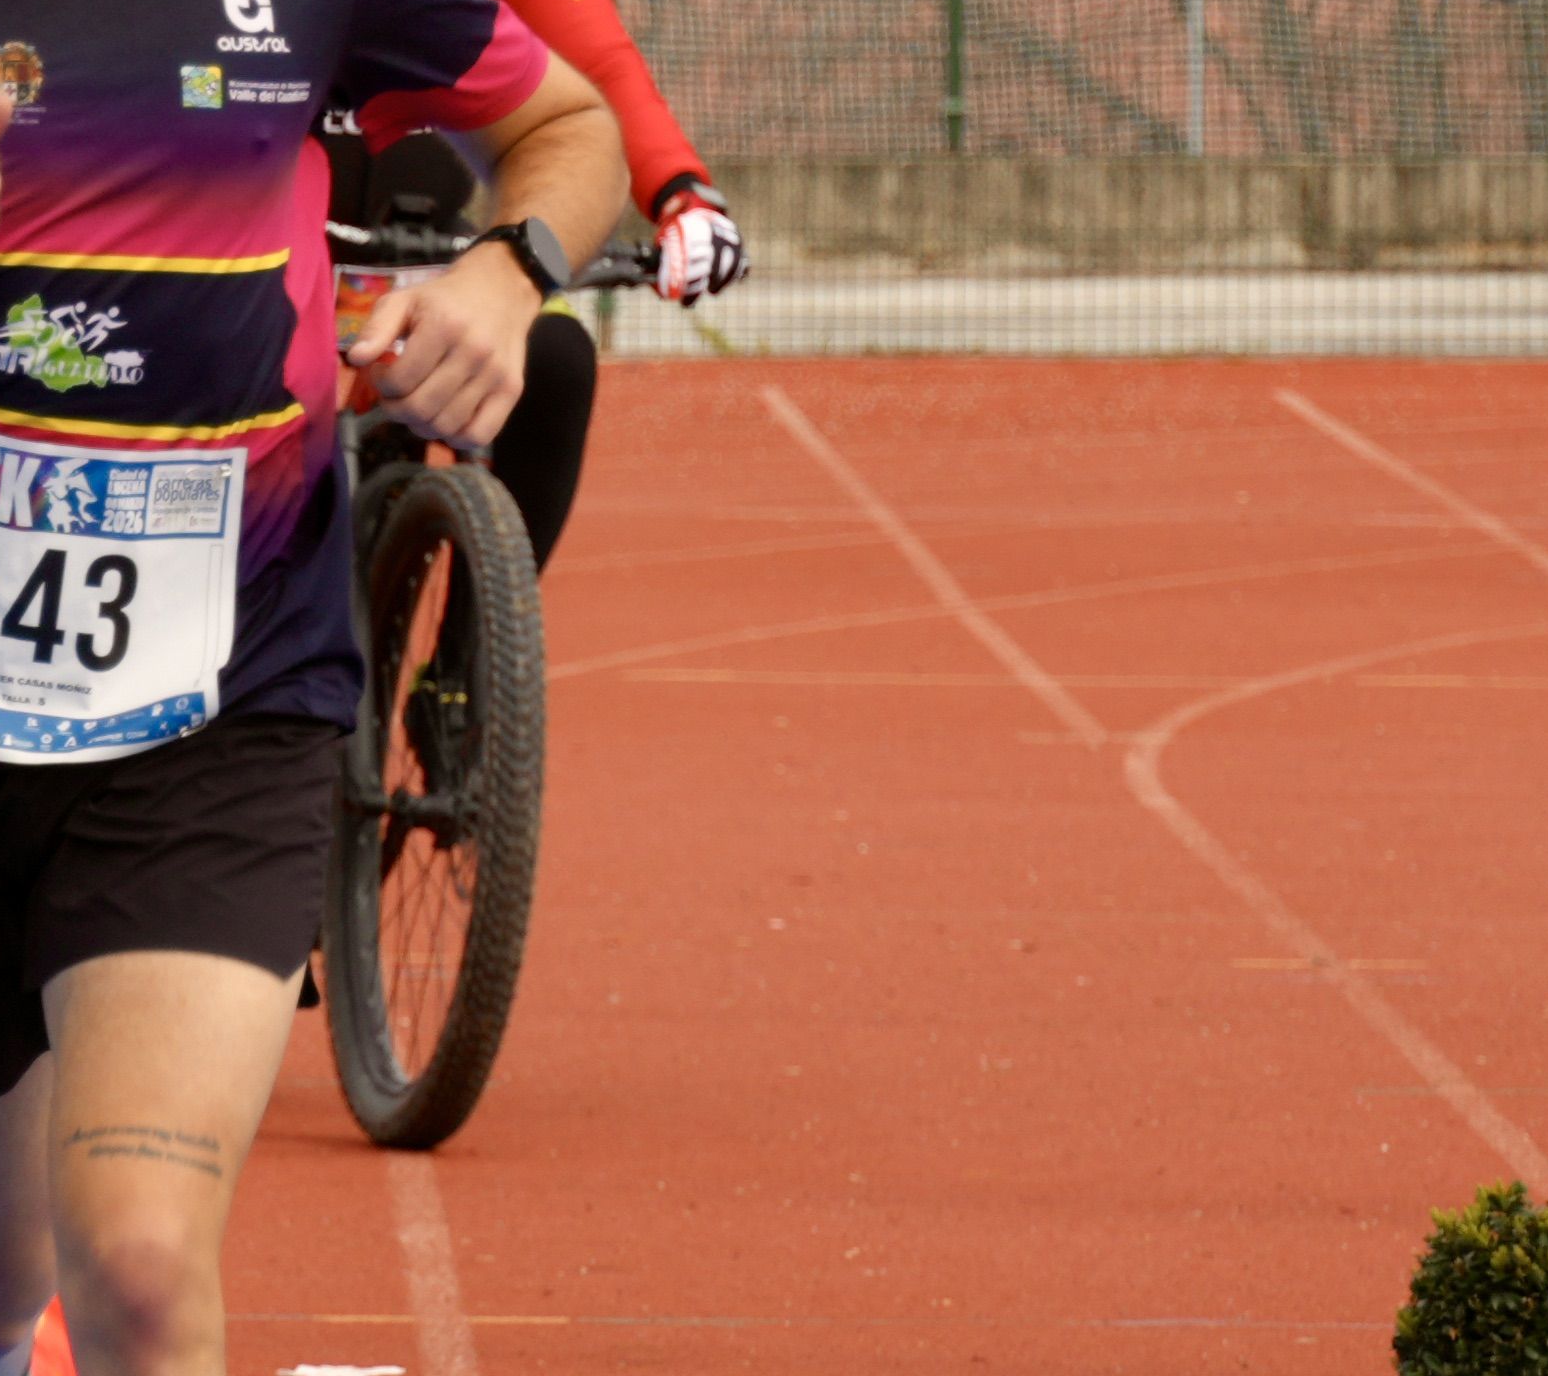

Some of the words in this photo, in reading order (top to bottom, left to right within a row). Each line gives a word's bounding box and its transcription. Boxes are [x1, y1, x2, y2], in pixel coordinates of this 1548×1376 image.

[217, 36, 291, 53] austral
[155, 478, 212, 489] carreras
[153, 486, 220, 504] populares
[101, 510, 144, 534] 2026
[17, 678, 53, 690] CASAS
[1, 693, 32, 704] TALLA
